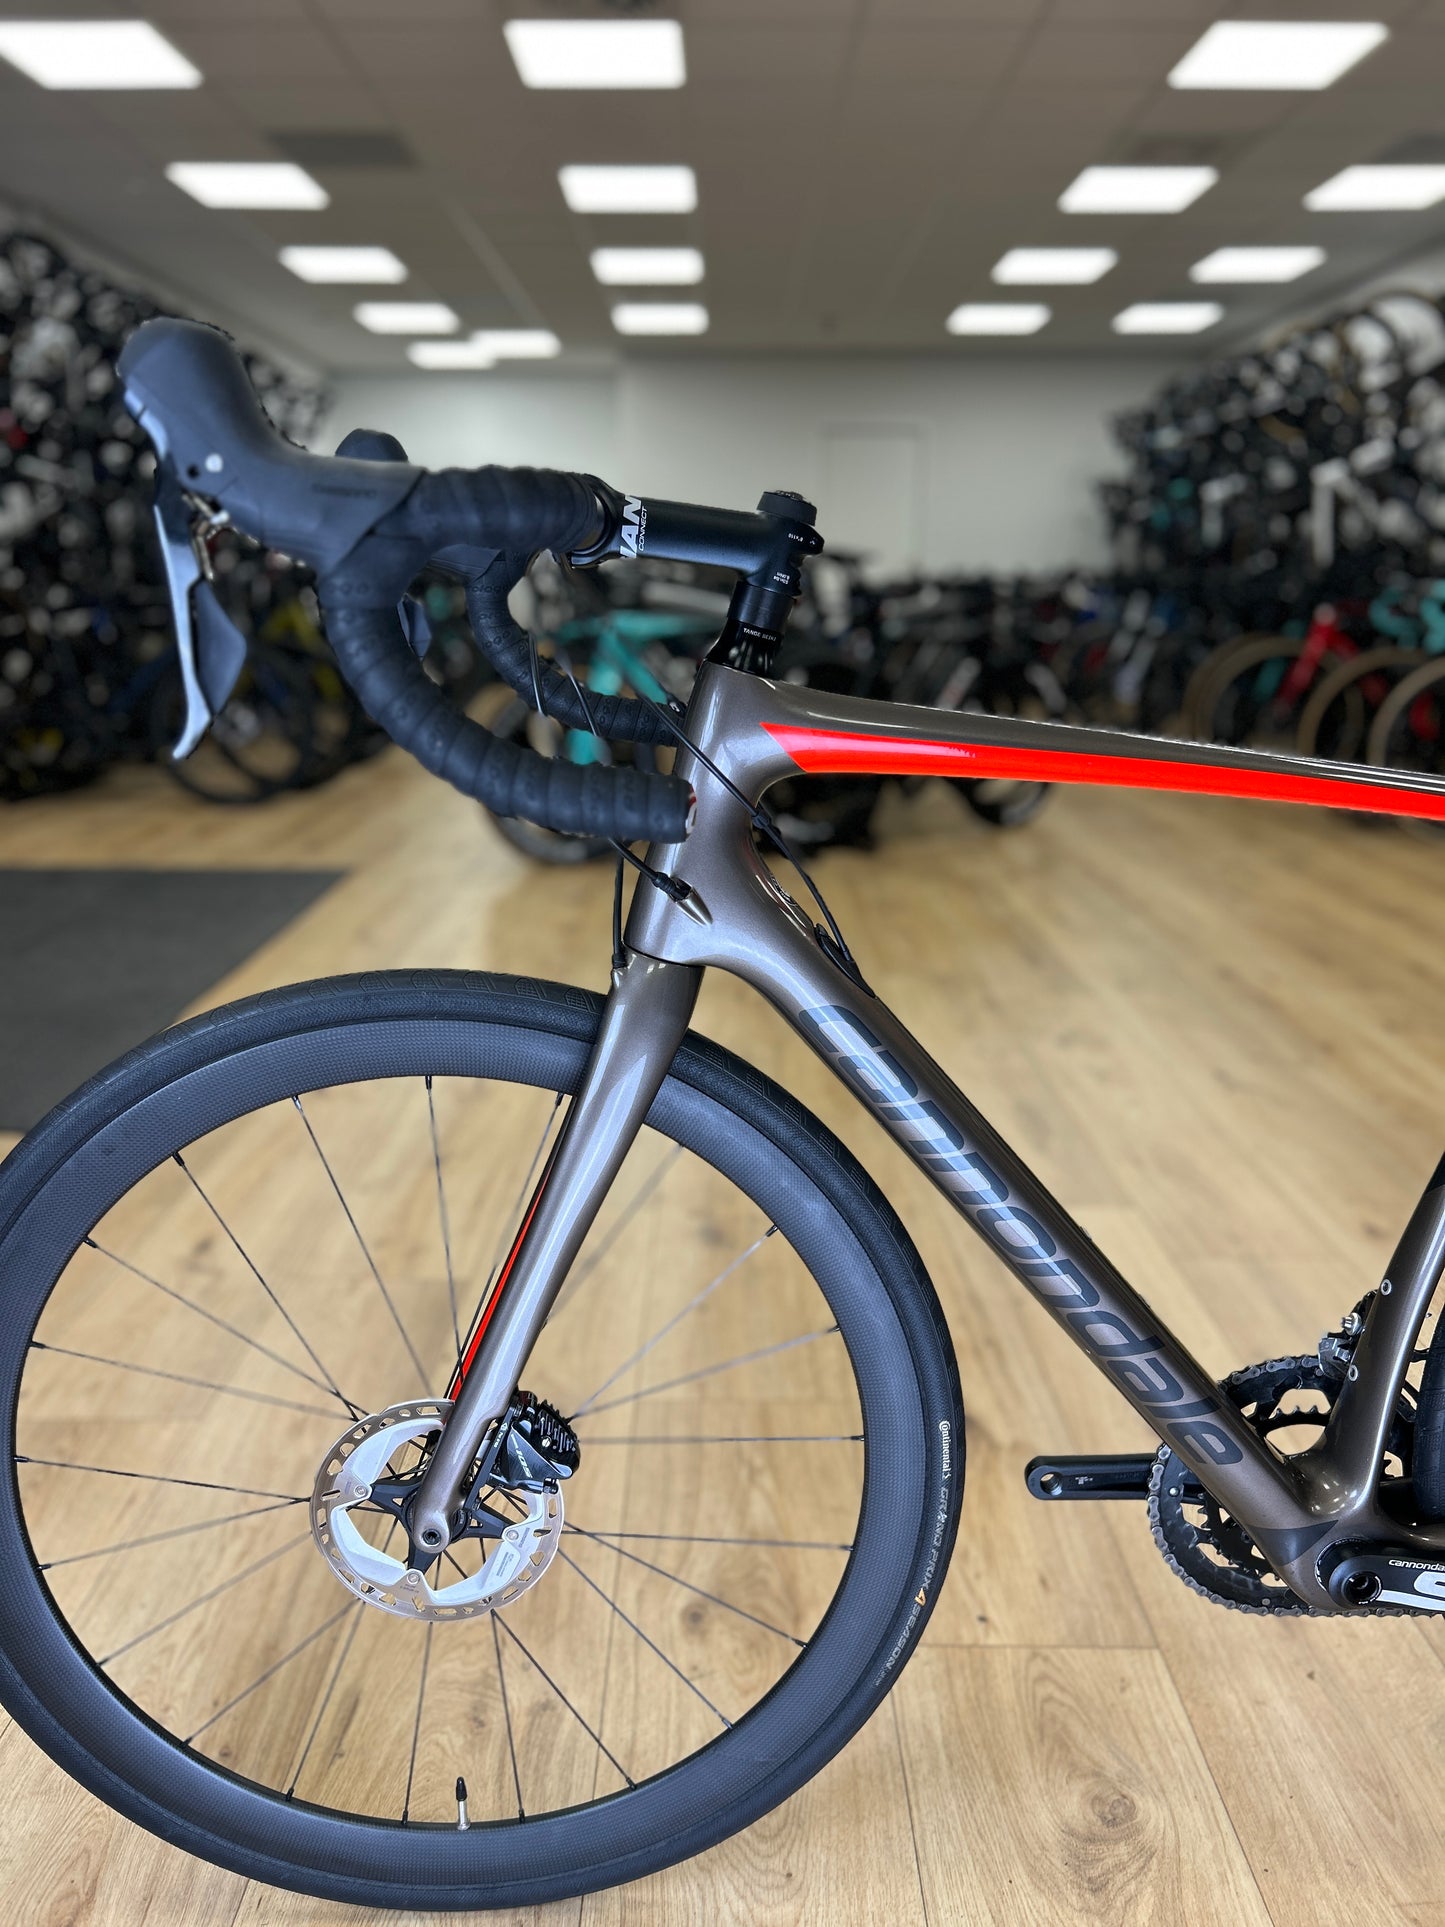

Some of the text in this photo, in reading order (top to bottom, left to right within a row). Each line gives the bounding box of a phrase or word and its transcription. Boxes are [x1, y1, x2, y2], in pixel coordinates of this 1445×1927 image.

[638, 505, 648, 552] CONNECT
[799, 1004, 1245, 1465] cannondale
[938, 1420, 952, 1472] Continental
[885, 1603, 920, 1671] SEASON
